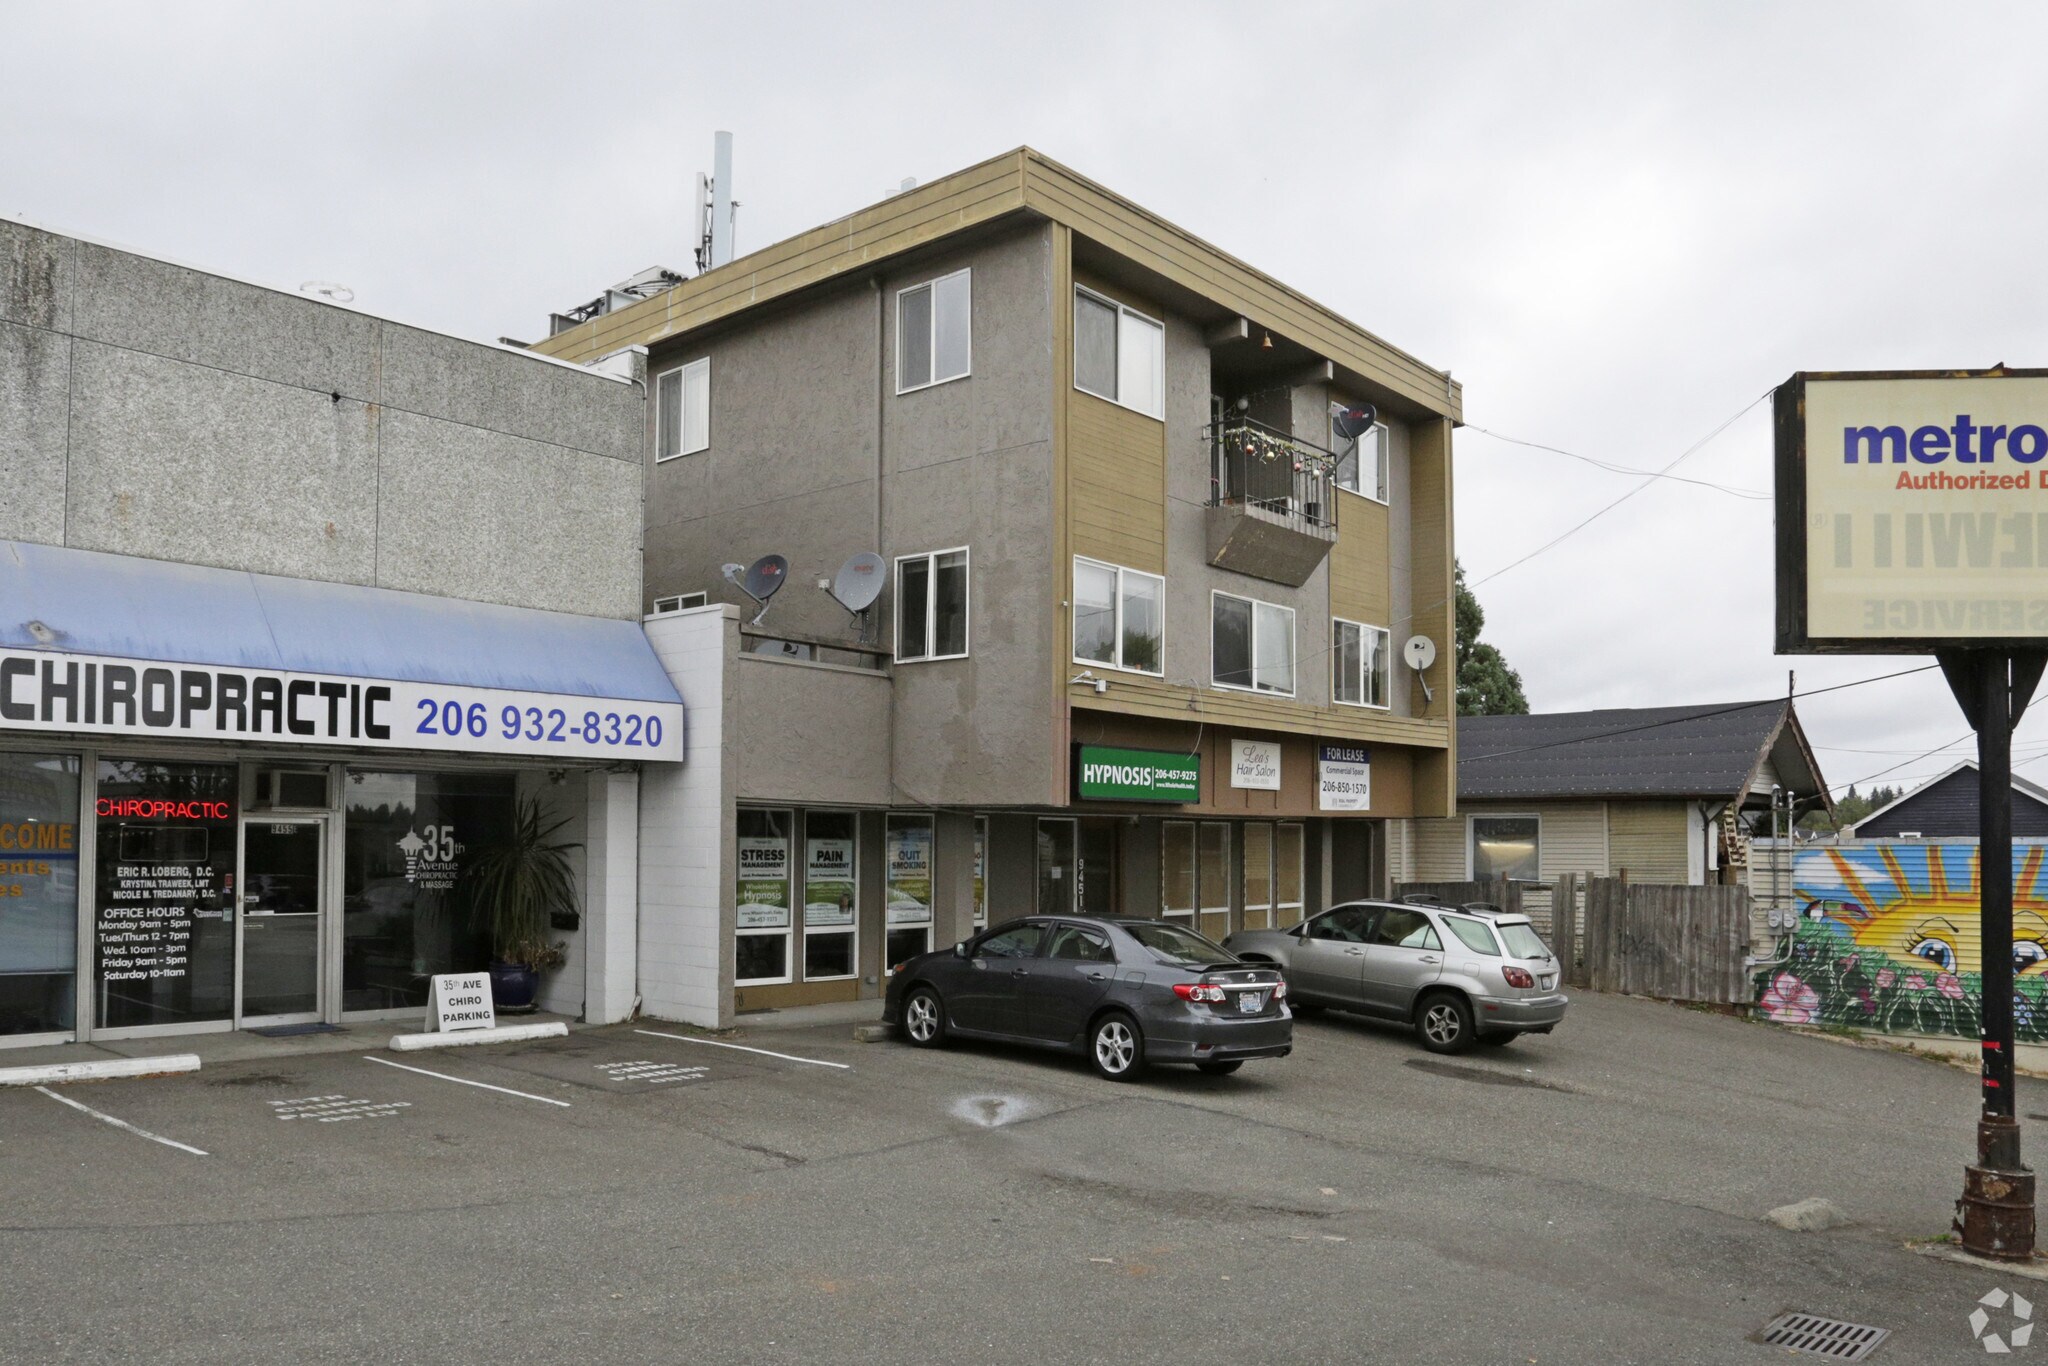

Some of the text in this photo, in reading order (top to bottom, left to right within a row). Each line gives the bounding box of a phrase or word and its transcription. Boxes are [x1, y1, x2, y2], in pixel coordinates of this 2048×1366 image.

[1844, 415, 2048, 464] metro
[1896, 470, 2030, 490] Authorized
[0, 656, 391, 740] CHIROPRACTIC
[416, 698, 663, 747] 206 932-8320
[1326, 747, 1364, 762] FOR LEASE
[1084, 764, 1197, 786] HYPNOSIS 206-457-9275
[1236, 763, 1276, 777] Hair Salon
[1326, 766, 1364, 776] Commercial Space
[1322, 780, 1367, 795] 206-850-1570
[95, 798, 229, 819] CHIROPRACTIC
[0, 822, 73, 850] COME
[741, 849, 785, 861] STRESS
[816, 850, 844, 862] PAIN
[898, 850, 921, 860] QUIT
[417, 860, 459, 870] Avenue
[892, 862, 927, 870] SMOKING
[117, 866, 214, 878] ERIC R. LOBERG, D.C.
[416, 872, 458, 880] CHIROPRACTIC
[120, 879, 210, 889] KRYSTINA TRAWEEK, LMT
[113, 889, 216, 900] NICOLE M. TREDANARY, D.C.
[744, 890, 782, 902] Hypnosis
[104, 907, 185, 919] OFFICE HOURS
[98, 920, 138, 931] Monday
[140, 920, 161, 928] 9am
[170, 919, 191, 929] 5pm
[99, 932, 150, 942] Tues/Thurs
[151, 932, 160, 941] 12
[169, 931, 190, 941] 7pm
[103, 946, 128, 955] Wed.
[130, 946, 156, 954] 10am
[165, 944, 186, 953] 3pm
[102, 958, 134, 968] Friday
[136, 957, 157, 966] 9am
[166, 956, 187, 965] 5pm
[104, 969, 185, 981] Saturday 10-11am
[444, 980, 482, 990] 35th AVE
[448, 996, 482, 1006] CHIRO
[443, 1011, 490, 1022] PARKING
[609, 1066, 710, 1081] PARKING
[274, 1099, 371, 1112] CHIRO
[276, 1101, 412, 1121] PARKING
[318, 1110, 400, 1122] ONLY
